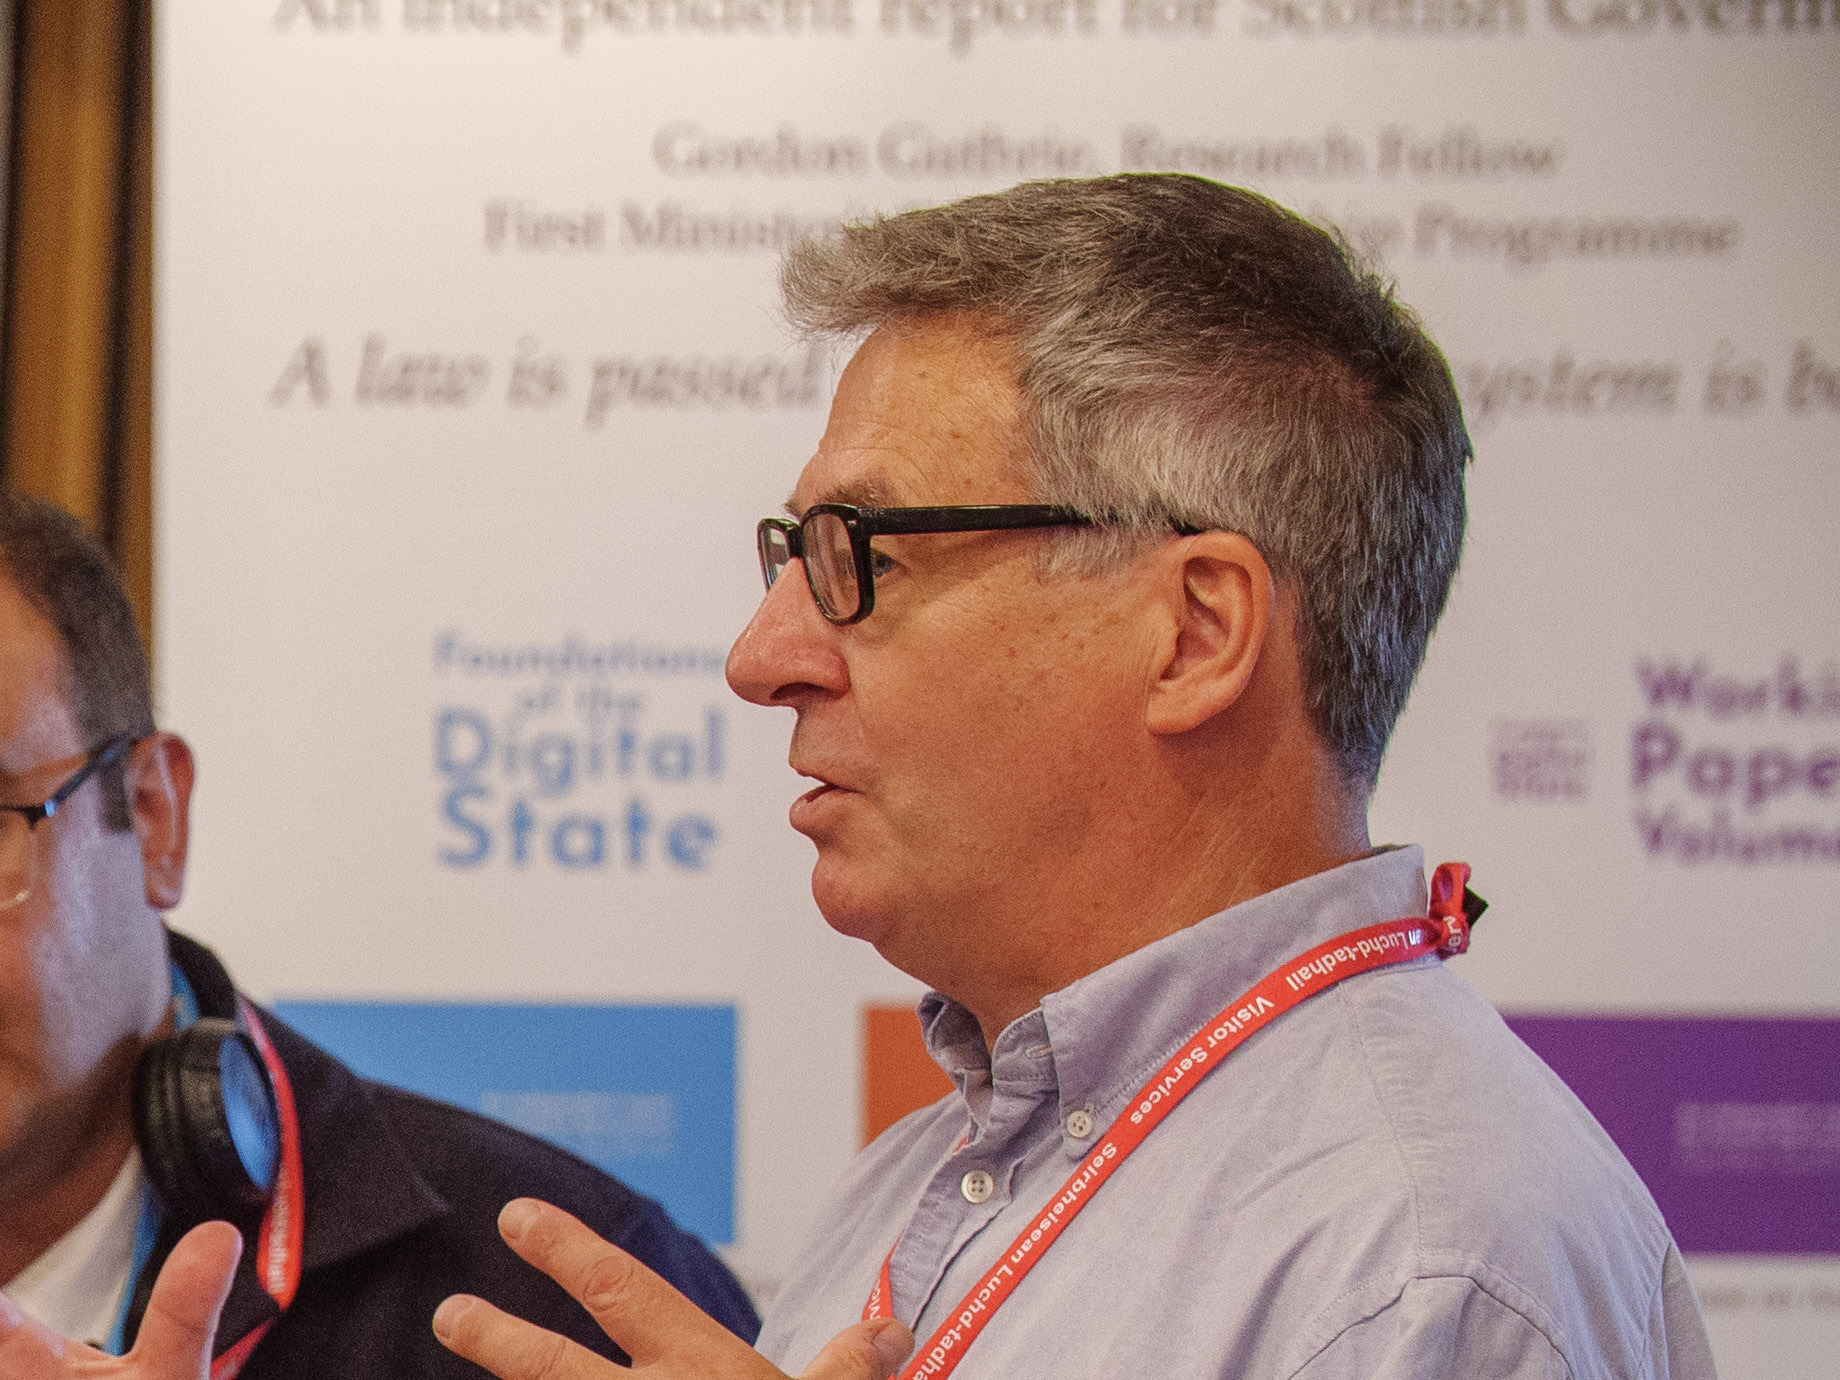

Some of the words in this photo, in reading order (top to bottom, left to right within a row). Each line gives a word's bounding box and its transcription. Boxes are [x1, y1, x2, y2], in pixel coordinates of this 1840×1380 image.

[482, 200, 604, 253] First
[1415, 212, 1741, 267] Programme
[270, 336, 331, 408] A
[355, 332, 490, 408] law
[433, 704, 726, 798] Digital
[437, 781, 718, 871] State
[1206, 995, 1275, 1050] Visitor
[1129, 1046, 1209, 1125] Services
